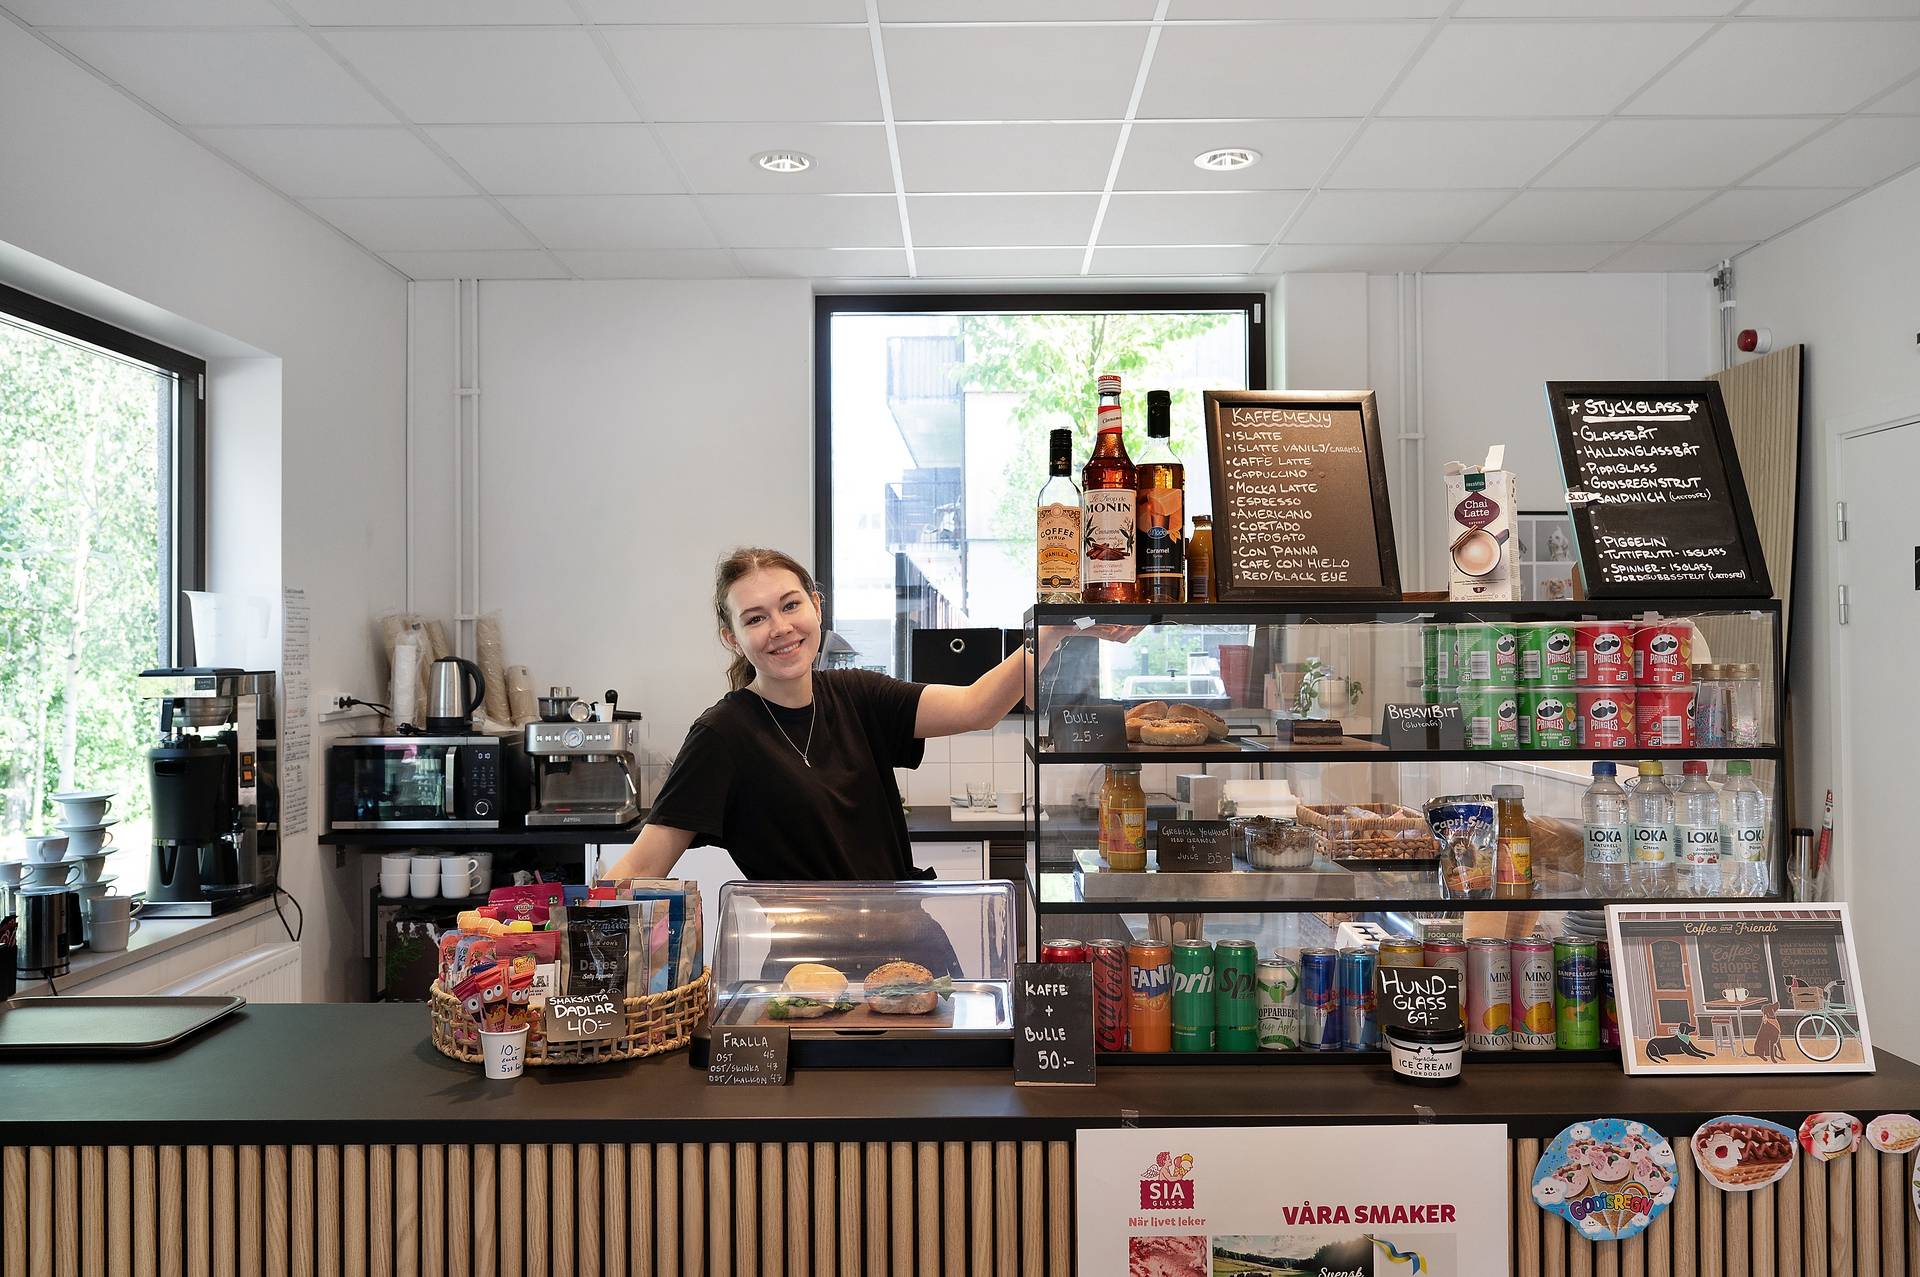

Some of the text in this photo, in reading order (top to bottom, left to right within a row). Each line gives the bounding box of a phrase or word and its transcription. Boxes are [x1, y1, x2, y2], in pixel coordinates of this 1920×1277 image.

[1584, 399, 1683, 417] STYCKGLASS
[1232, 408, 1332, 427] KAFFEMENY
[1232, 431, 1282, 441] ISLATTE
[1581, 426, 1657, 442] GLASSBÅT
[1233, 444, 1279, 453] ISLATTE
[1586, 443, 1700, 457] HALLONGLASSBÅT
[1278, 457, 1311, 466] LATTE
[1233, 469, 1307, 479] CAPPUCCINO
[1236, 482, 1318, 494] MOCKA LATTE
[1591, 477, 1701, 489] GODISREGNSTRUT
[1086, 503, 1130, 512] MONIN
[1237, 497, 1301, 507] ESPRESSO
[1465, 500, 1487, 509] Chai
[1237, 509, 1312, 520] AMERICANO
[1464, 509, 1489, 518] Latte
[1240, 522, 1300, 532] CORTADO
[1041, 528, 1074, 538] COFFEE
[1240, 533, 1305, 543] AFFOGATO
[1603, 537, 1667, 548] PIGGELIN
[1239, 545, 1318, 557] CON PANNA
[1683, 548, 1727, 557] ISGLASS
[1240, 558, 1349, 569] CAFE CON HIELO
[1242, 571, 1348, 582] RED/BLACK EYE
[1547, 653, 1571, 664] PRINGLES
[1593, 654, 1621, 664] PRINGLES
[1650, 654, 1677, 665] PRINGLES
[1063, 710, 1099, 724] BULLE
[1388, 706, 1459, 719] BISKVIBIT
[1536, 719, 1564, 730] PRINGLES
[1591, 720, 1618, 730] PRINGLES
[1432, 815, 1491, 833] Capri-Sun
[1590, 830, 1622, 842] LOKA
[1635, 829, 1667, 841] LOKA
[1688, 832, 1719, 843] LOKA
[1684, 922, 1778, 935] Coffee and Friends
[1711, 962, 1759, 973] SHOPPE
[1525, 971, 1552, 981] MINO
[1380, 970, 1457, 995] HUND-
[1025, 981, 1068, 997] KAFFE
[549, 994, 608, 1005] SMAKSATTA
[1392, 996, 1446, 1010] GLASS
[555, 1002, 617, 1018] DADLAR
[1278, 1020, 1296, 1034] Apple
[723, 1032, 769, 1048] FRALLA
[1025, 1027, 1066, 1042] BULLE
[716, 1053, 734, 1062] OST
[1399, 1060, 1452, 1071] ICE CREAM
[1149, 1183, 1185, 1200] SIA
[1282, 1201, 1456, 1225] VÅRA SMAKER
[1128, 1216, 1206, 1226] När livet leker
